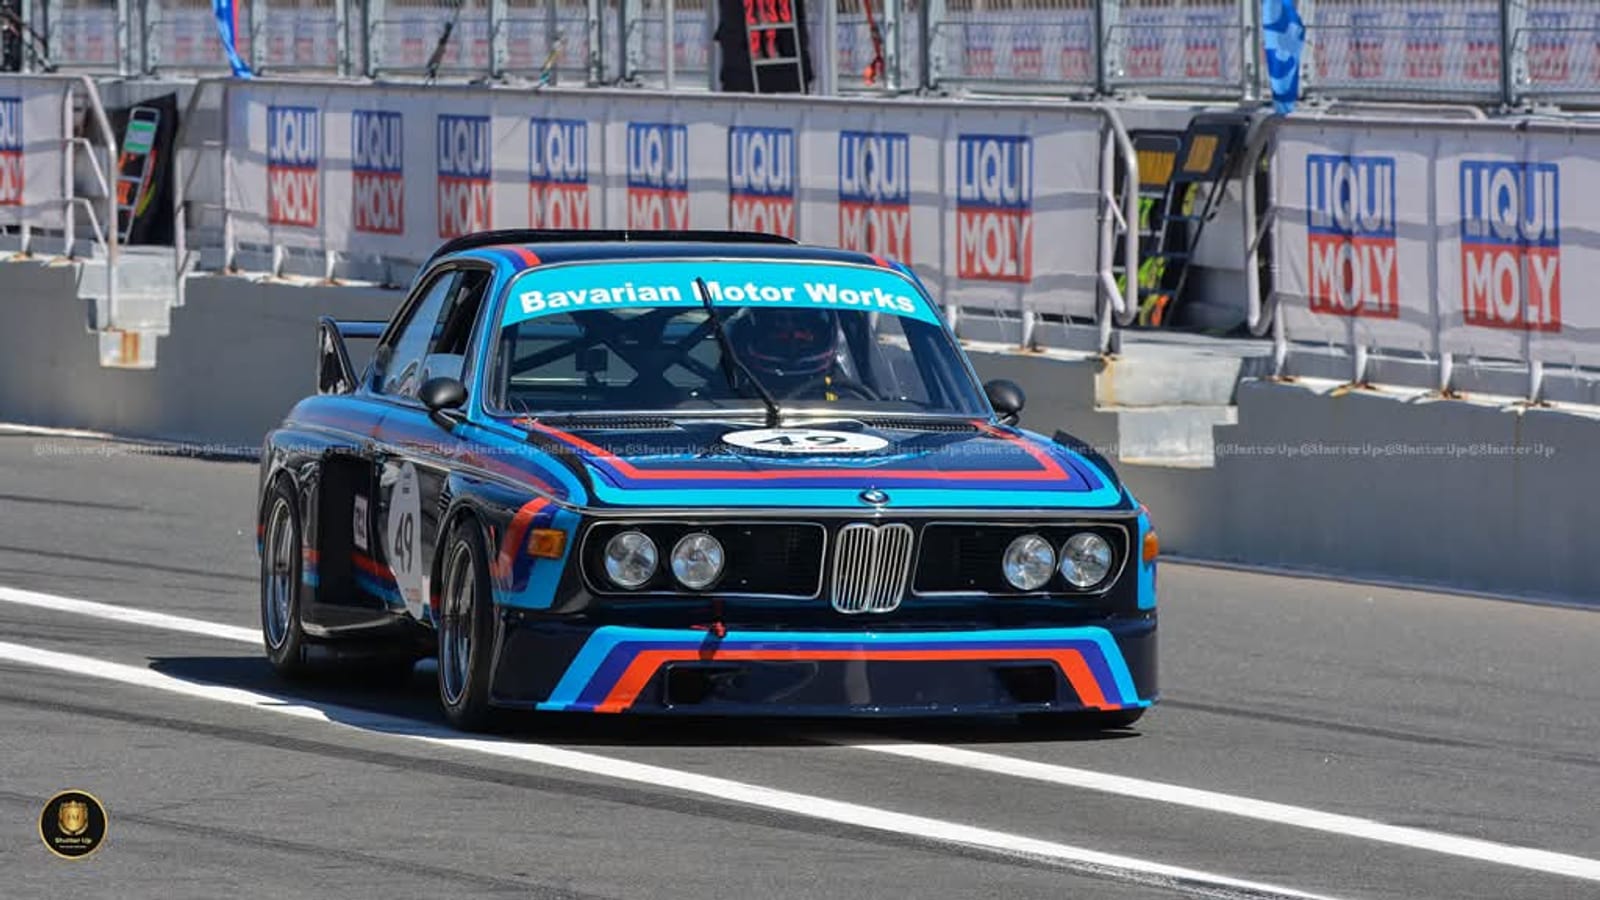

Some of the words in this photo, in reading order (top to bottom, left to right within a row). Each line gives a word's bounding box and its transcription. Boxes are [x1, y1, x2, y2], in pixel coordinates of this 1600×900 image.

[354, 114, 401, 169] LIQUI
[440, 120, 490, 176] LIQUI
[732, 131, 791, 192] LIQUI
[841, 136, 906, 199] LIQUI
[961, 140, 1029, 204] LIQUI
[356, 175, 402, 228] MOLY
[440, 180, 492, 233] MOLY
[1310, 161, 1391, 233] LIQUI
[1464, 168, 1556, 242] LIQUI
[841, 205, 908, 262] MOLY
[960, 211, 1030, 275] MOLY
[519, 282, 682, 314] Bavarian
[803, 282, 916, 313] Works
[1312, 240, 1394, 311] MOLY
[1466, 250, 1557, 323] MOLY
[754, 435, 847, 446] 49
[394, 512, 413, 574] 49
